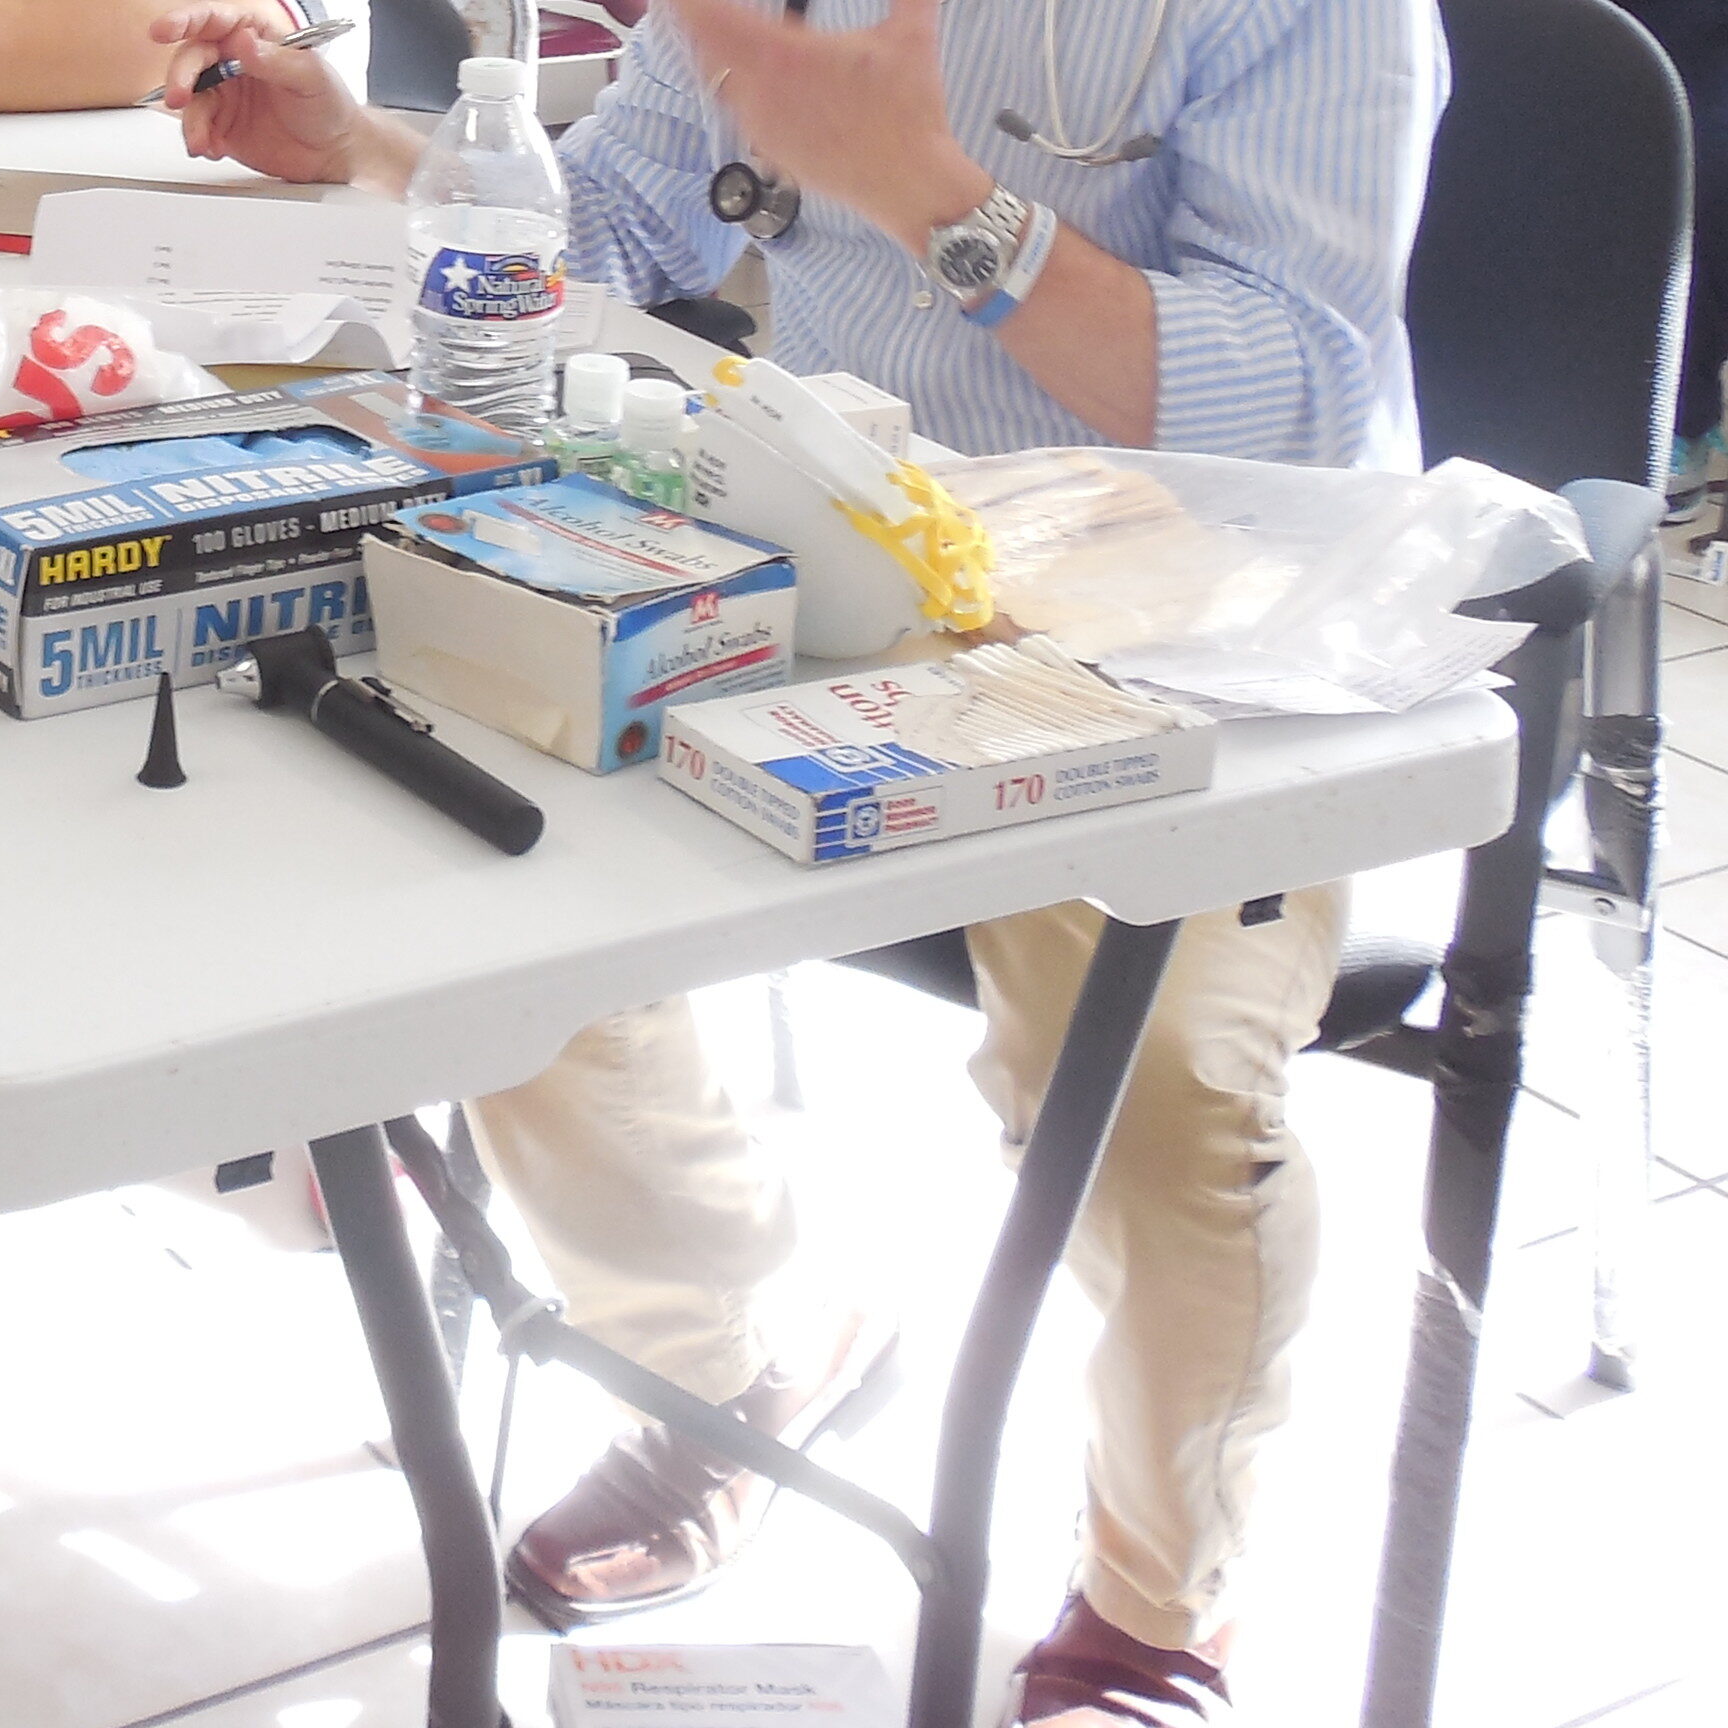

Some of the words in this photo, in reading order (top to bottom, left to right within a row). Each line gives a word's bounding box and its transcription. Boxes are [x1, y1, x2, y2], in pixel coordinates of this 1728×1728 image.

[452, 291, 519, 319] Spring
[478, 273, 543, 296] Natural
[157, 396, 236, 415] MEDIUM
[236, 390, 283, 408] DUTY
[149, 455, 418, 505] NITRILE
[174, 479, 333, 515] DISPOSABLE
[1, 491, 145, 542] 5MIL
[192, 528, 227, 555] 100
[232, 516, 302, 549] GLOVES
[320, 500, 398, 533] MEDIUM
[518, 494, 628, 541] Alcohol
[626, 533, 719, 571] Swabs
[39, 534, 172, 588] HARDY
[40, 615, 165, 699] 5MIL
[664, 735, 706, 780] 170
[993, 773, 1046, 811] 170
